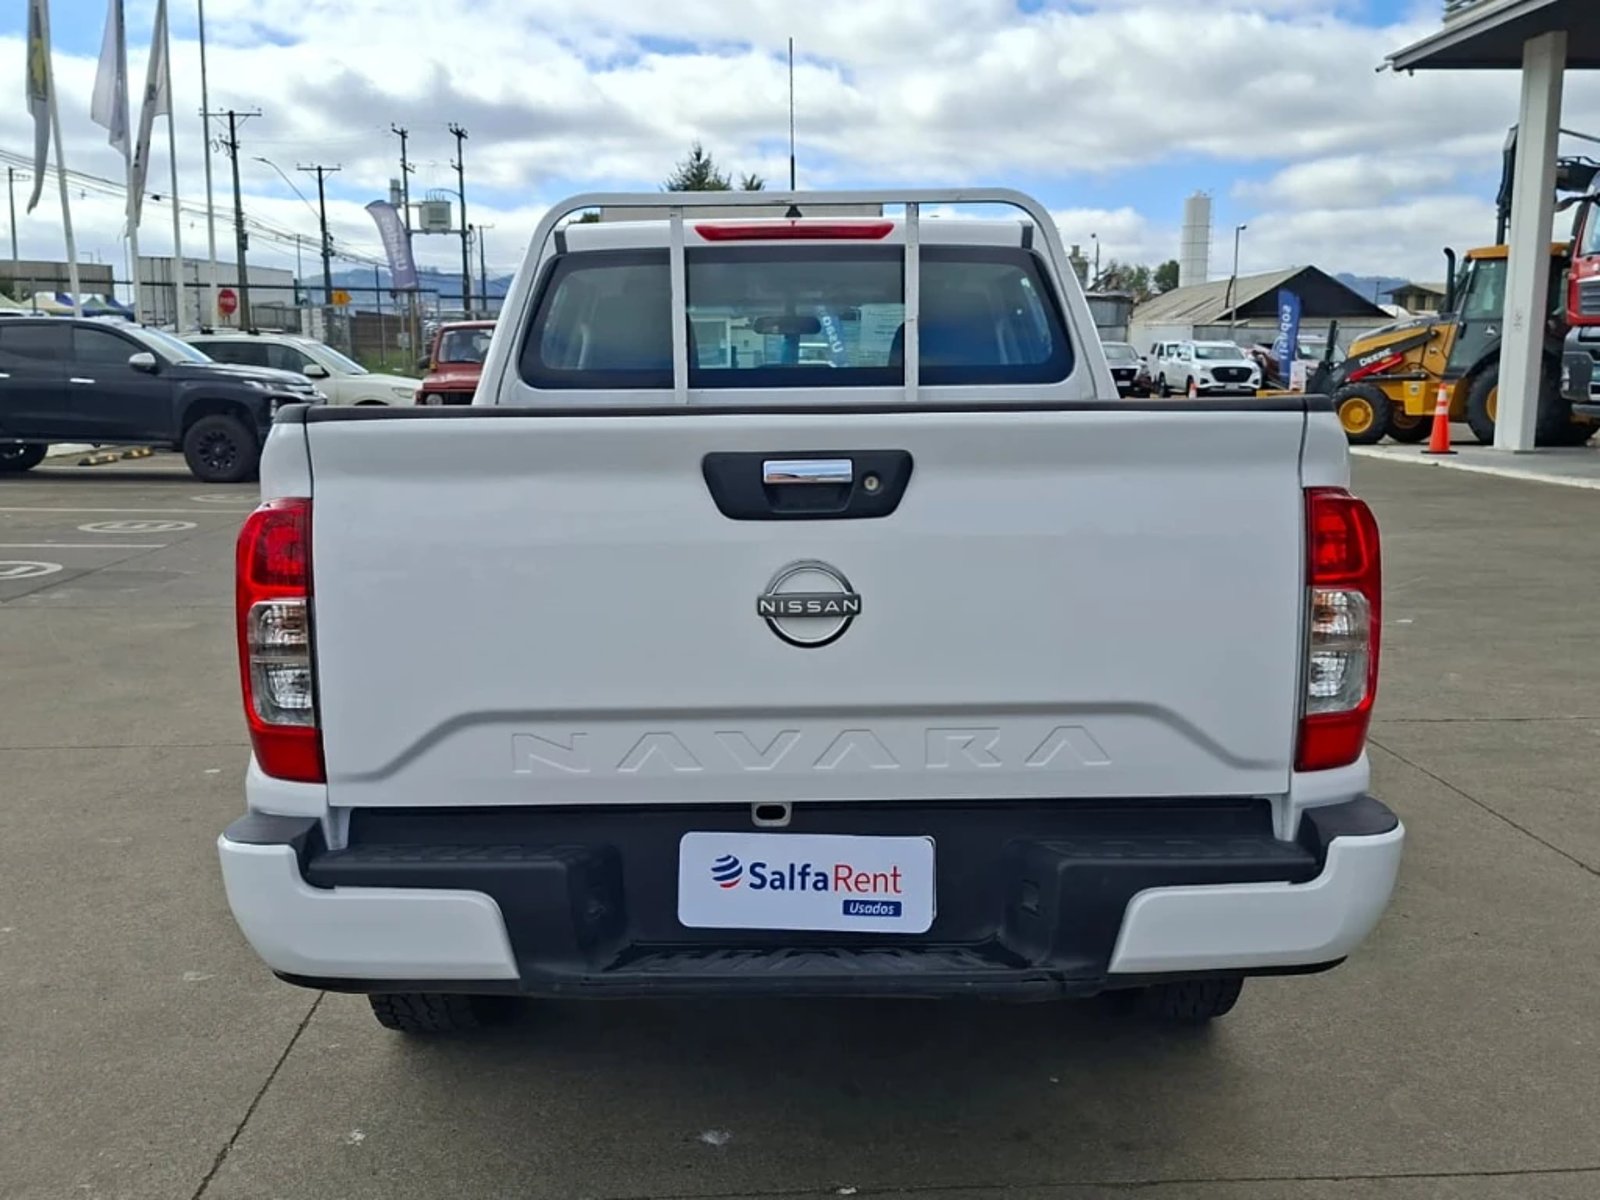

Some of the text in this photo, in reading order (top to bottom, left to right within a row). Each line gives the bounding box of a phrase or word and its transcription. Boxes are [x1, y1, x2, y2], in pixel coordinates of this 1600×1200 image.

[760, 599, 859, 613] NISSAN
[511, 726, 1112, 774] NAVARA
[849, 901, 895, 915] Usados
